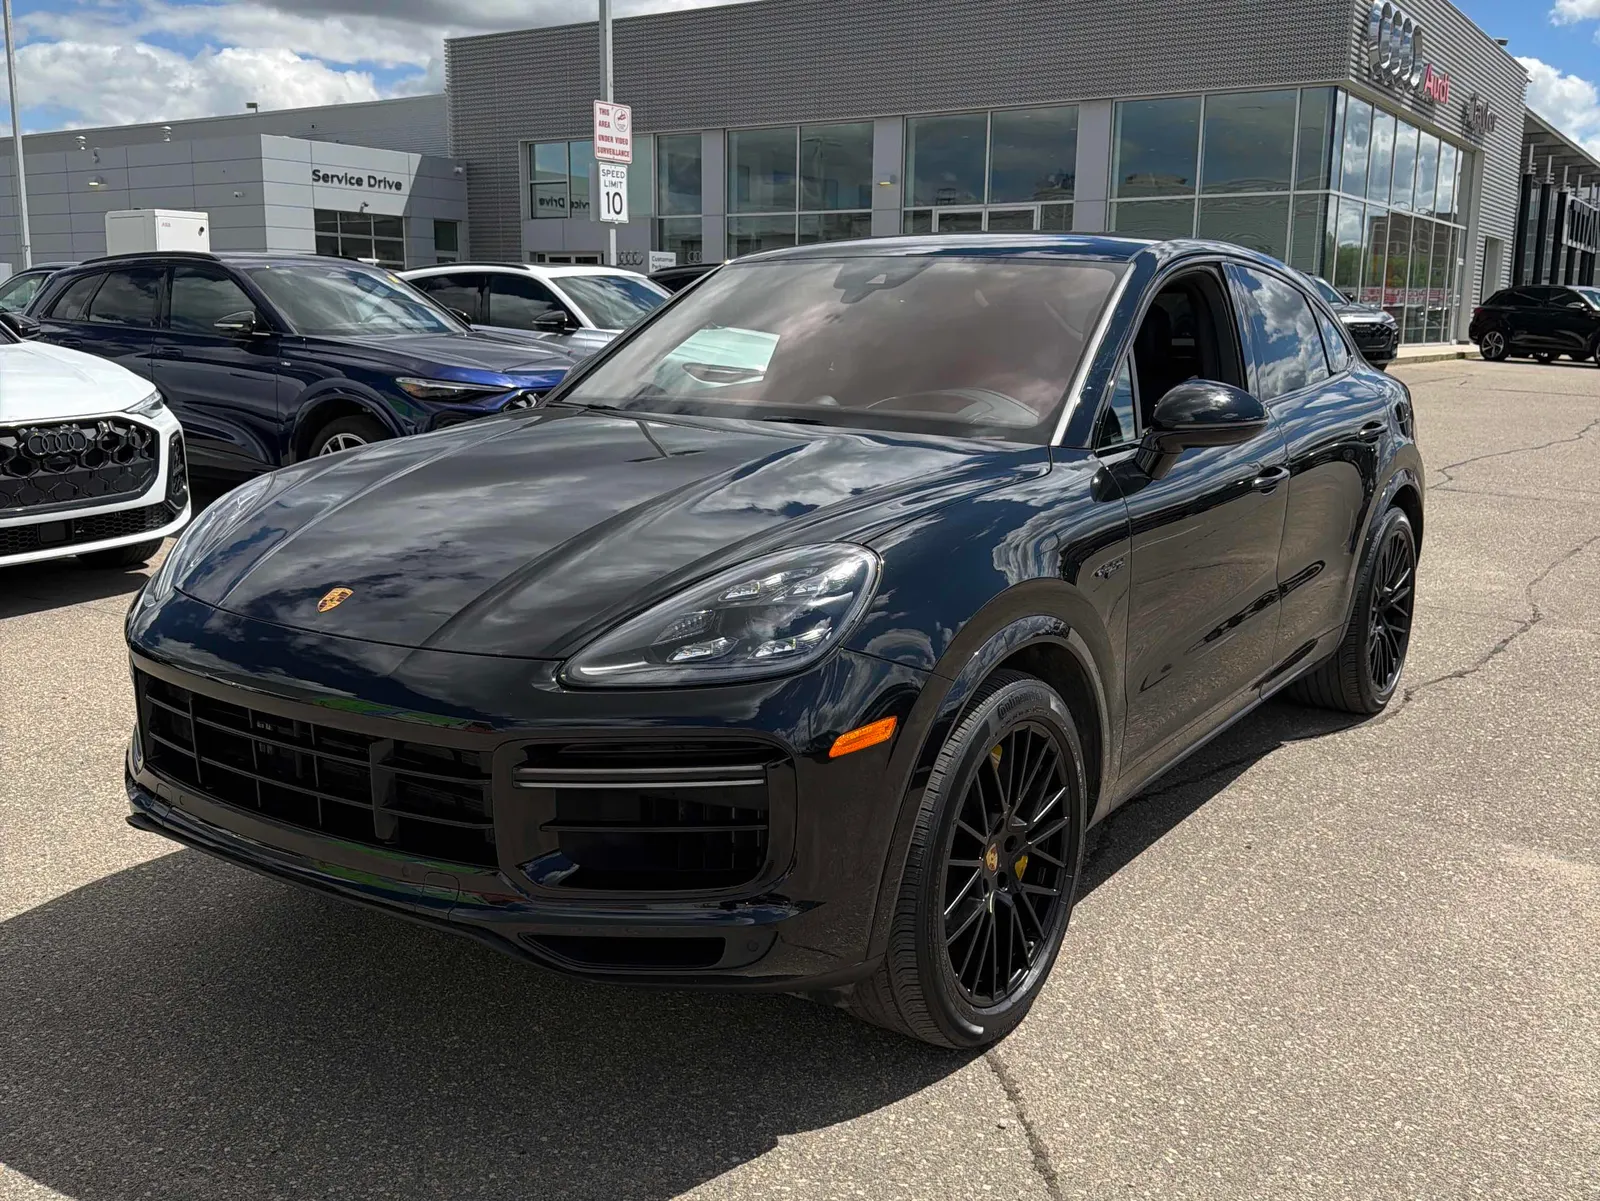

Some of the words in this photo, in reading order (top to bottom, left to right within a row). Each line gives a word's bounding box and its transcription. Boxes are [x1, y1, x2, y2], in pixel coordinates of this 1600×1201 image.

[1423, 63, 1450, 105] Audi
[599, 107, 610, 116] THIS
[598, 120, 611, 128] AREA
[598, 134, 614, 143] UNDER
[615, 136, 628, 145] VIDEO
[597, 146, 630, 157] SURVEILLANCE
[601, 169, 625, 179] SPEED
[312, 169, 363, 187] Service
[367, 175, 403, 191] Drive
[603, 180, 622, 189] LIMIT
[605, 191, 623, 215] 10
